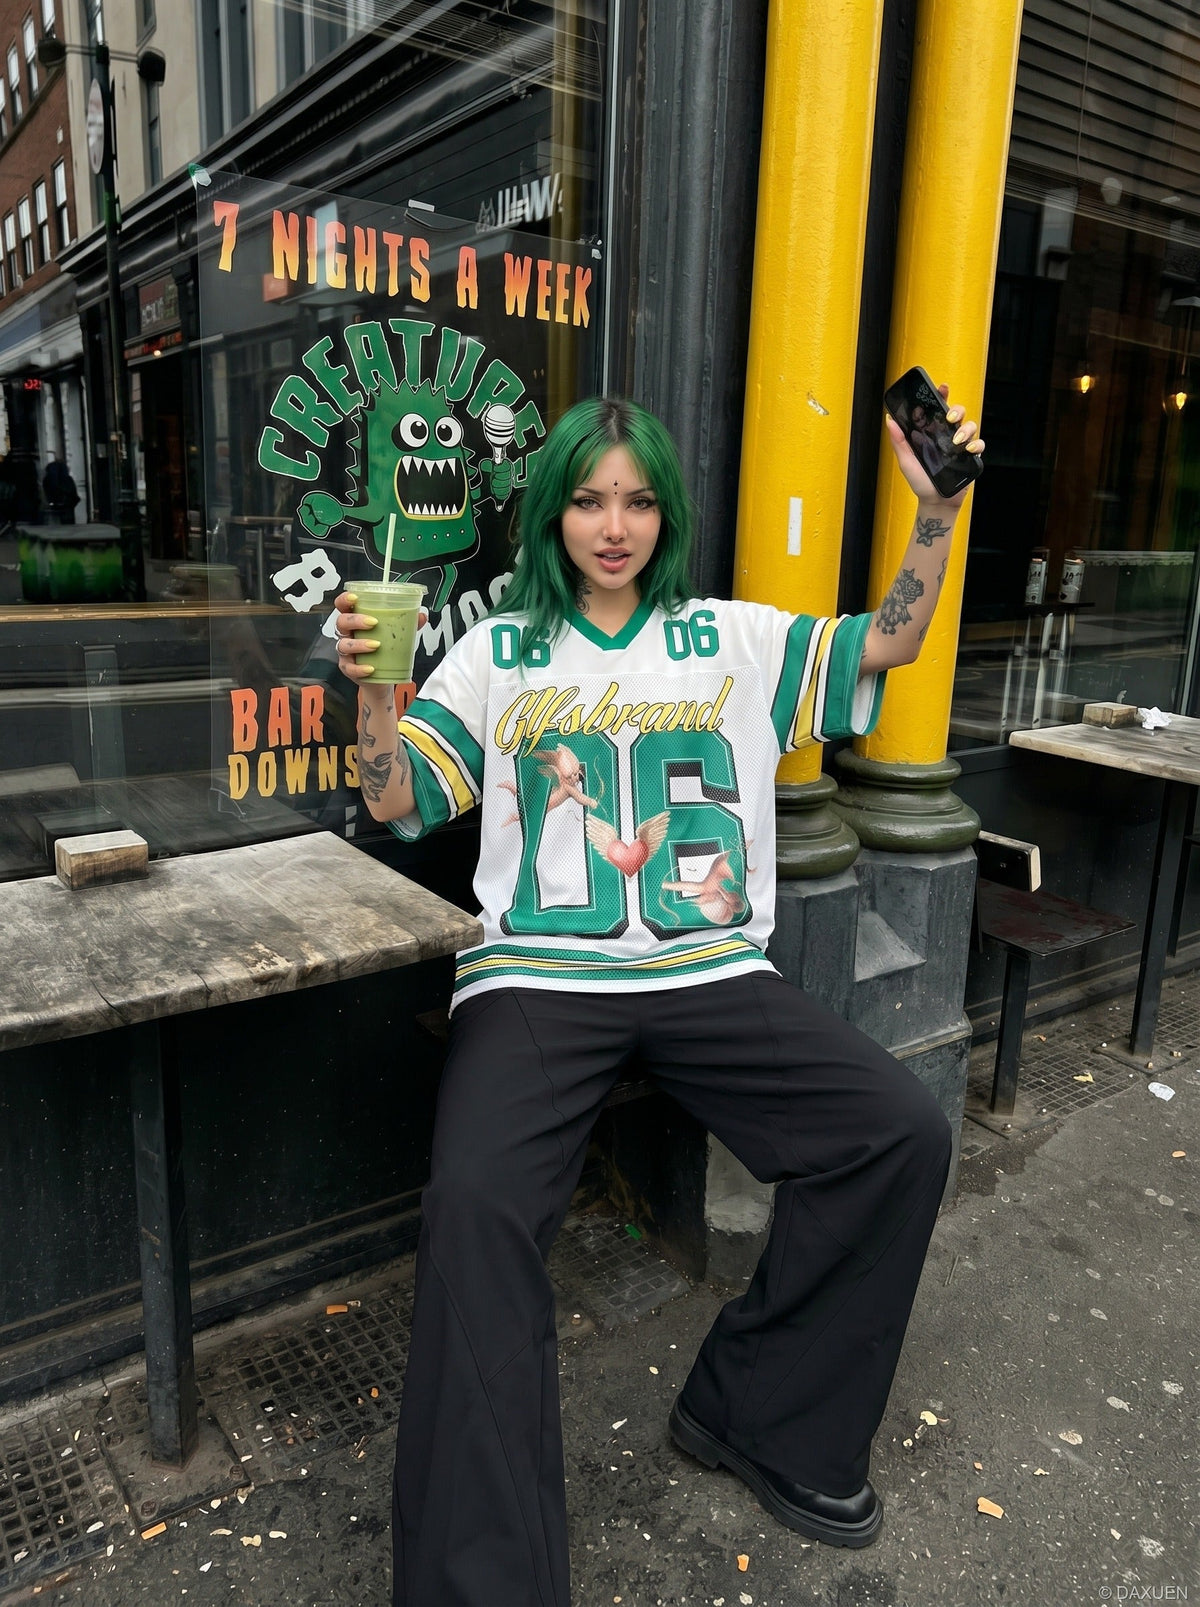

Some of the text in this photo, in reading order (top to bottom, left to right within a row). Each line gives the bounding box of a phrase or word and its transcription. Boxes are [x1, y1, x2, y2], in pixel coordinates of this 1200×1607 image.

[212, 199, 593, 328] 7 NIGHTS A WEEK
[491, 623, 551, 669] 06
[663, 609, 720, 662] 06
[230, 685, 325, 753] BAR
[500, 728, 753, 941] 06
